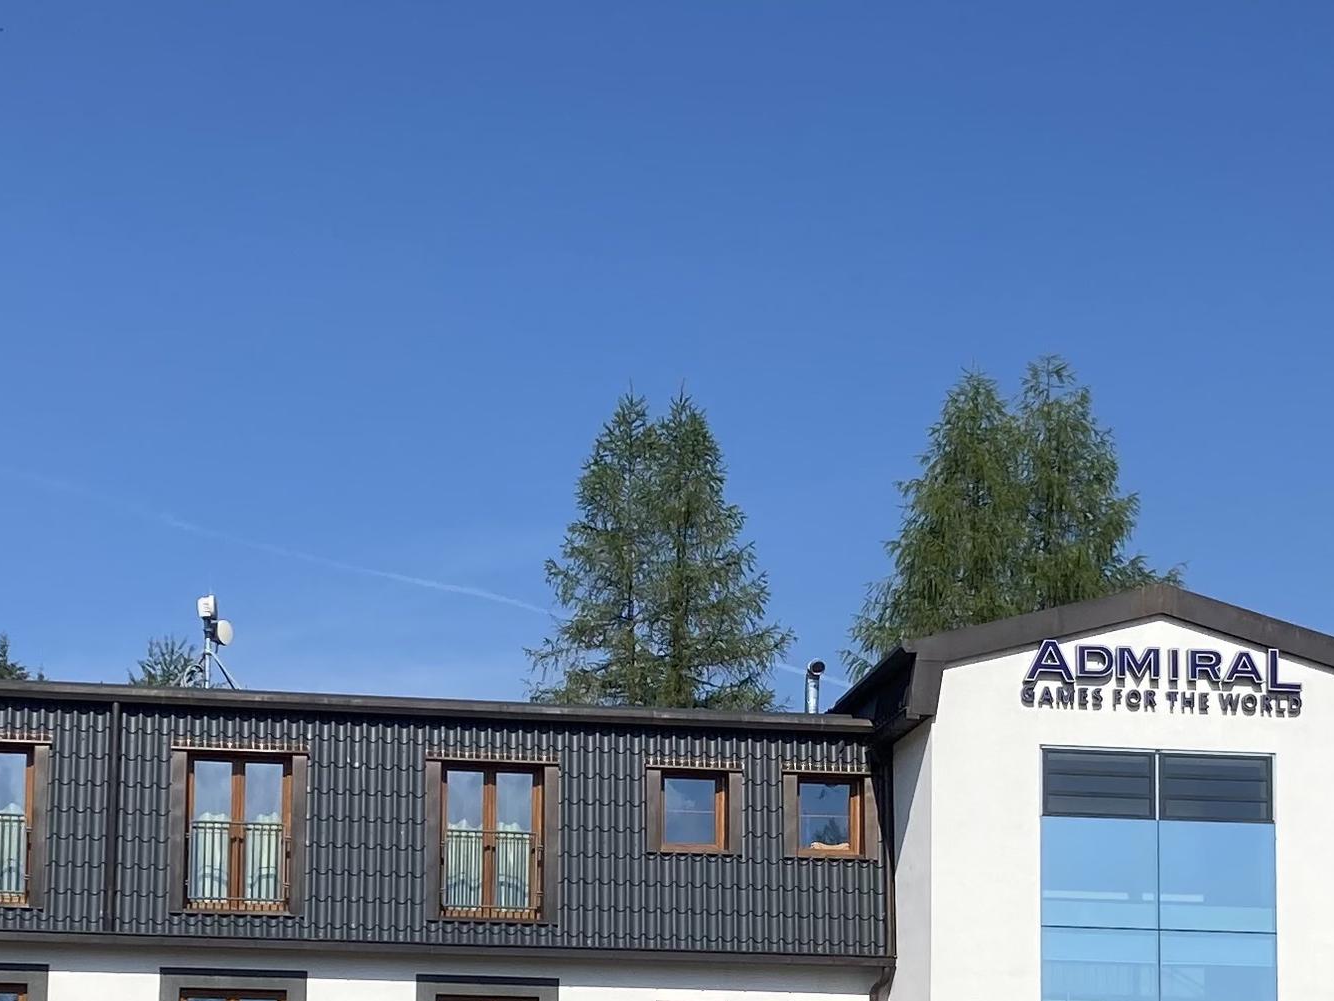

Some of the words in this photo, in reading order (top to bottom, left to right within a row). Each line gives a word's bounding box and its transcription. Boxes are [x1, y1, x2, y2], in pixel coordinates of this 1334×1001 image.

[1023, 639, 1302, 693] ADMIRAL
[1020, 685, 1103, 710] GAMES
[1112, 688, 1157, 712] FOR
[1165, 691, 1209, 715] THE
[1218, 692, 1302, 718] WORLD
